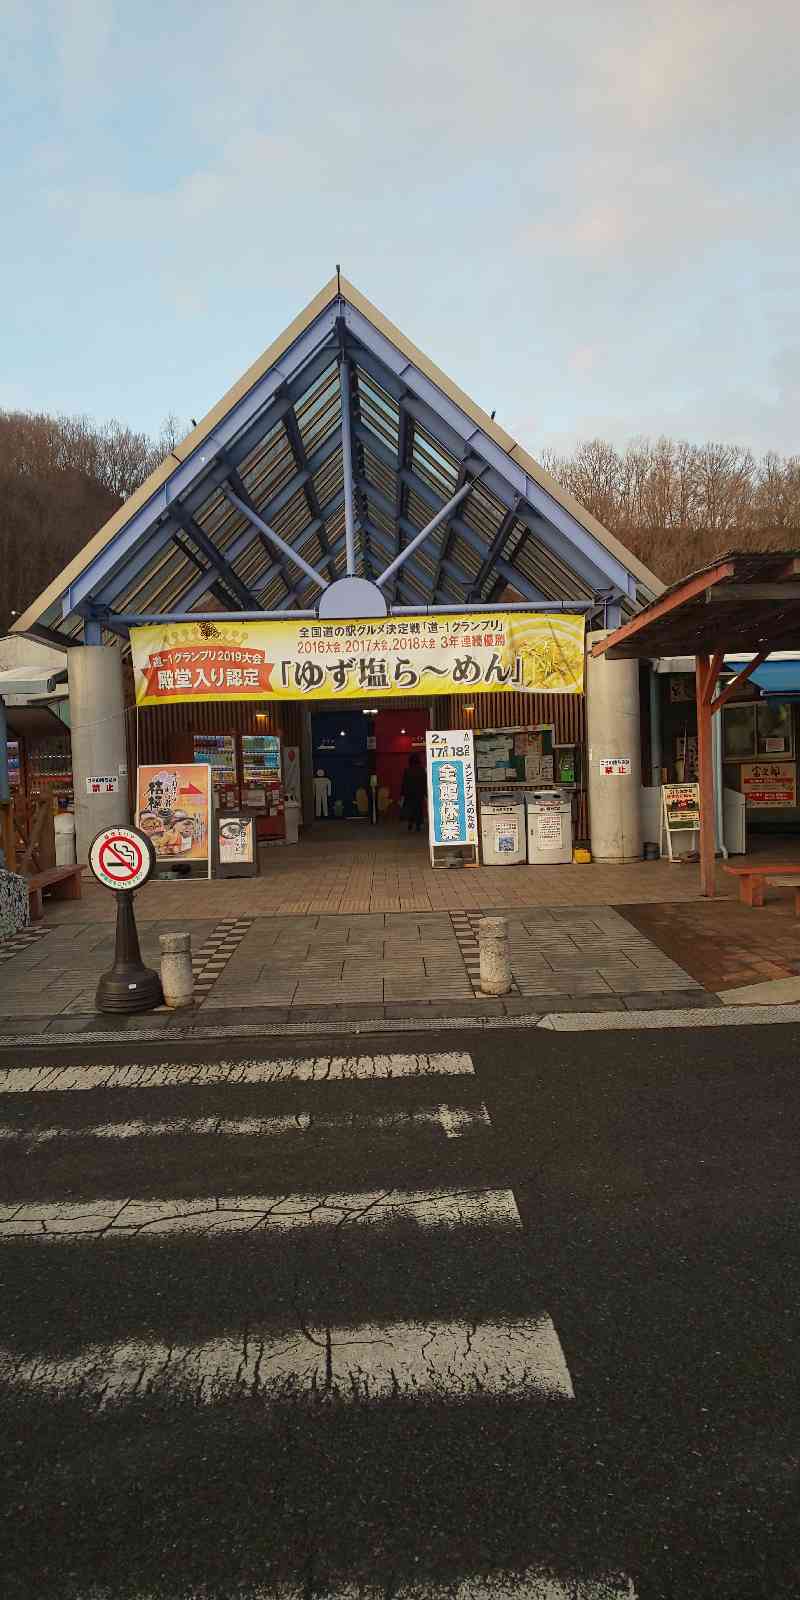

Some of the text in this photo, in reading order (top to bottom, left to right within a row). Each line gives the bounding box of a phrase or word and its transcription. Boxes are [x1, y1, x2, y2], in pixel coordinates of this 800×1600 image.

[158, 668, 260, 690] 殿堂入り認定
[431, 734, 447, 744] 2月
[92, 784, 114, 793] 禁止
